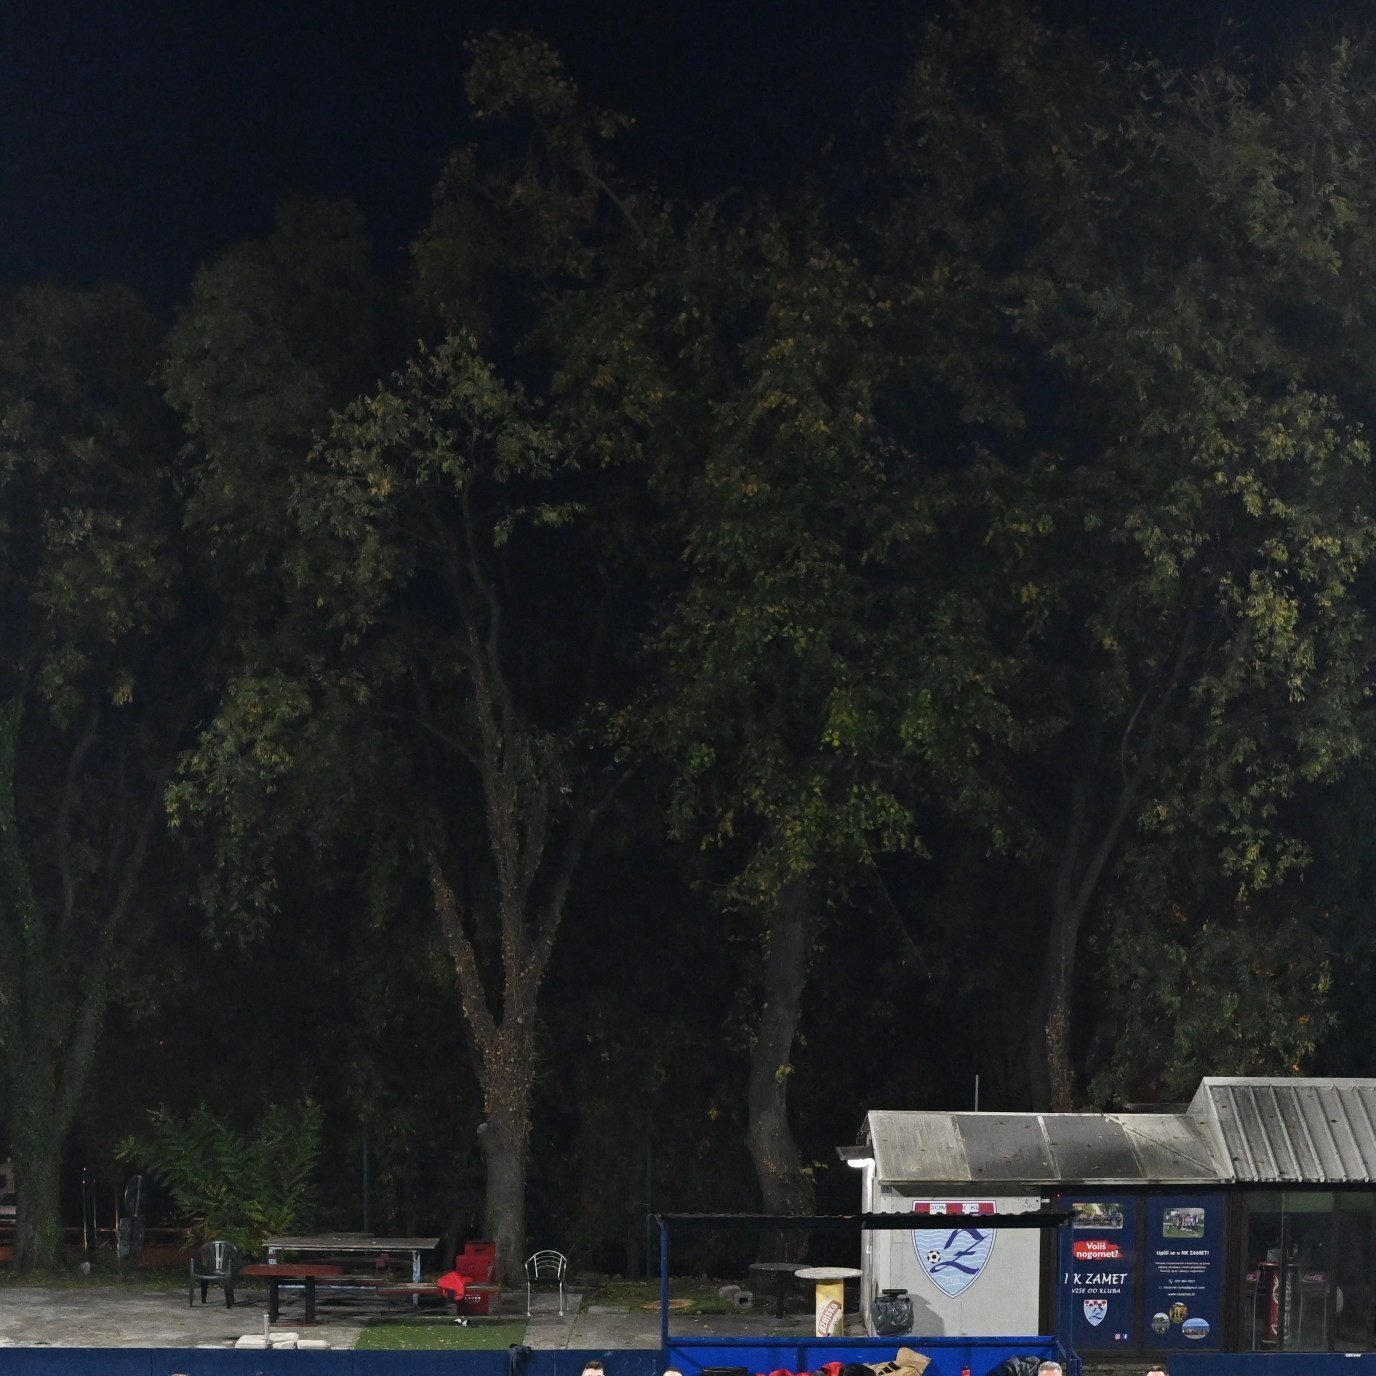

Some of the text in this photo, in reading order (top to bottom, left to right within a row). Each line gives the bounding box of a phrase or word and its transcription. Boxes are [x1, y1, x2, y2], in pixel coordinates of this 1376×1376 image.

[1086, 1242, 1106, 1250] Voliš
[1076, 1250, 1119, 1259] nogomet?
[1085, 1273, 1128, 1285] ZAMET
